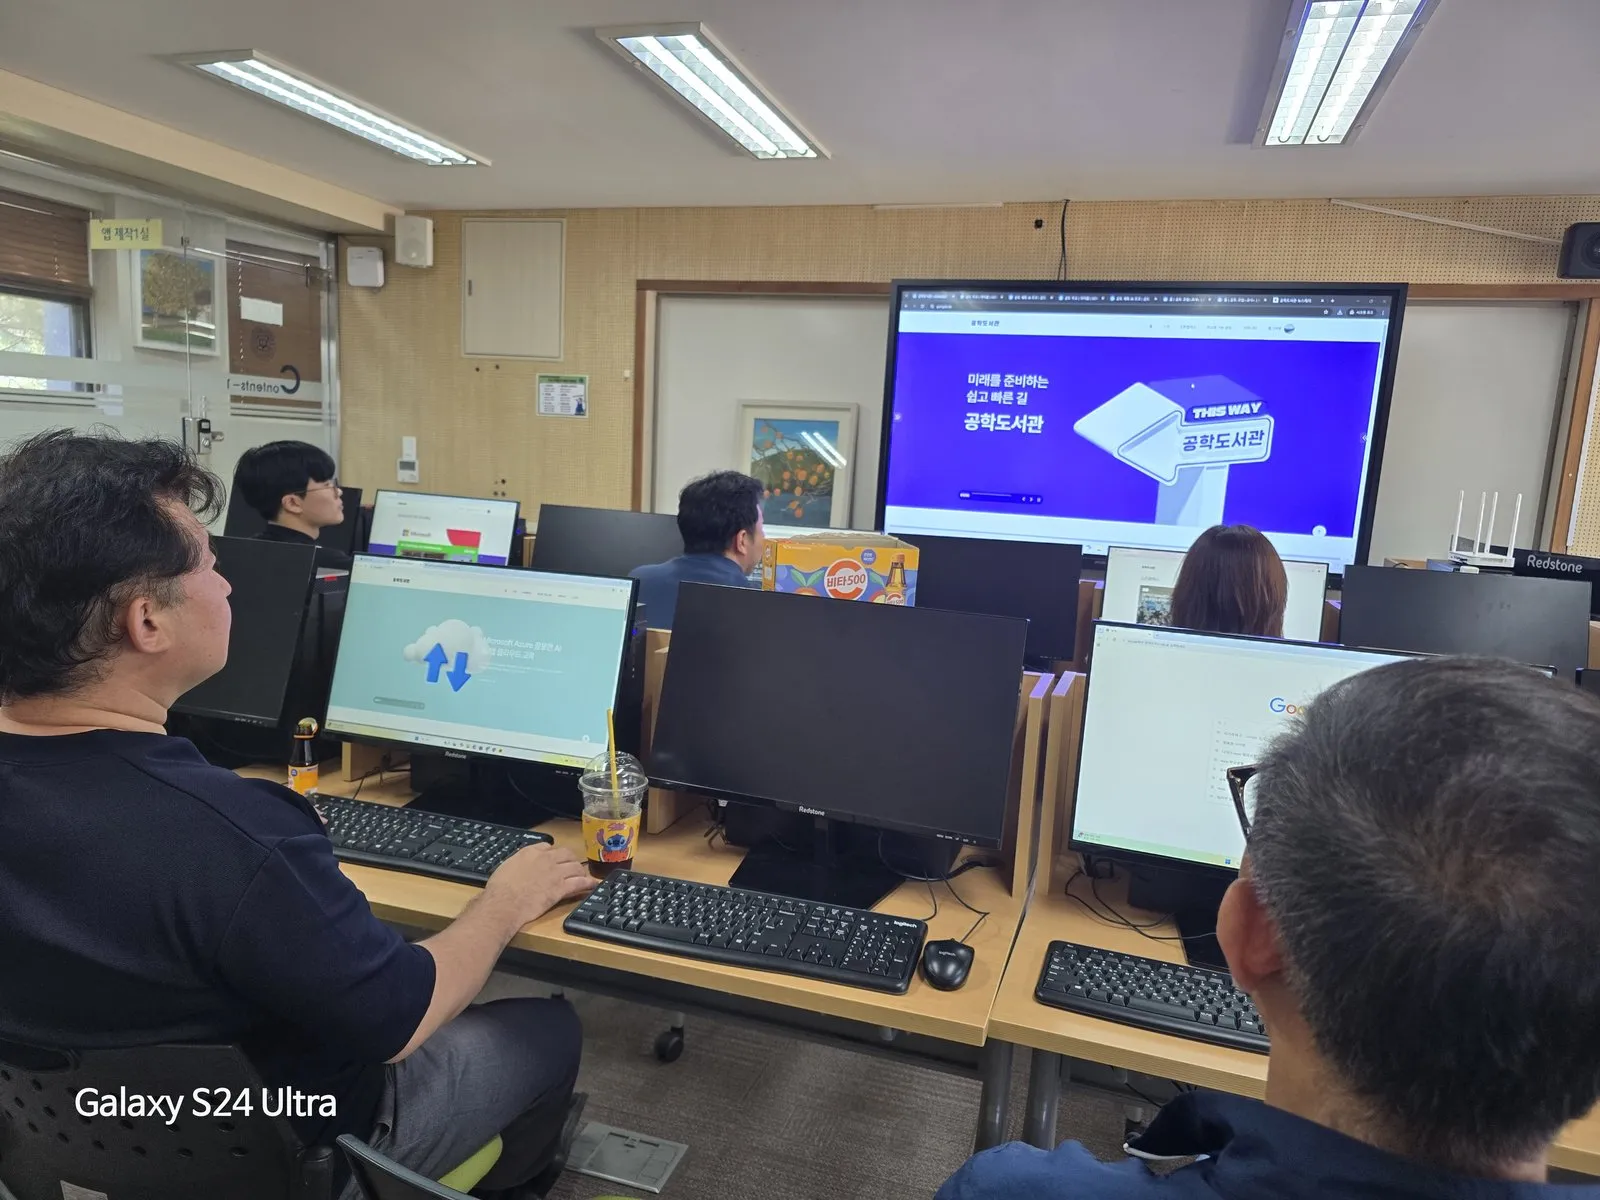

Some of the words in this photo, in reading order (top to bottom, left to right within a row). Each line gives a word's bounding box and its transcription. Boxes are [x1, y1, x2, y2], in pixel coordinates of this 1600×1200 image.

[102, 226, 111, 241] 앱
[968, 373, 1001, 388] 미래를
[1004, 374, 1049, 389] 준비하는
[967, 390, 989, 404] 쉽고
[991, 391, 1013, 405] 빠른
[1017, 391, 1028, 405] 길
[1193, 405, 1227, 419] THIS
[1228, 402, 1262, 416] WAY
[964, 412, 1044, 433] 공학도서관
[1183, 430, 1265, 452] 공학도서관
[1527, 555, 1583, 574] Redstone
[826, 573, 866, 588] 비타500
[1270, 697, 1305, 715] Goo
[799, 805, 825, 817] Redstone
[894, 920, 917, 928] logitech
